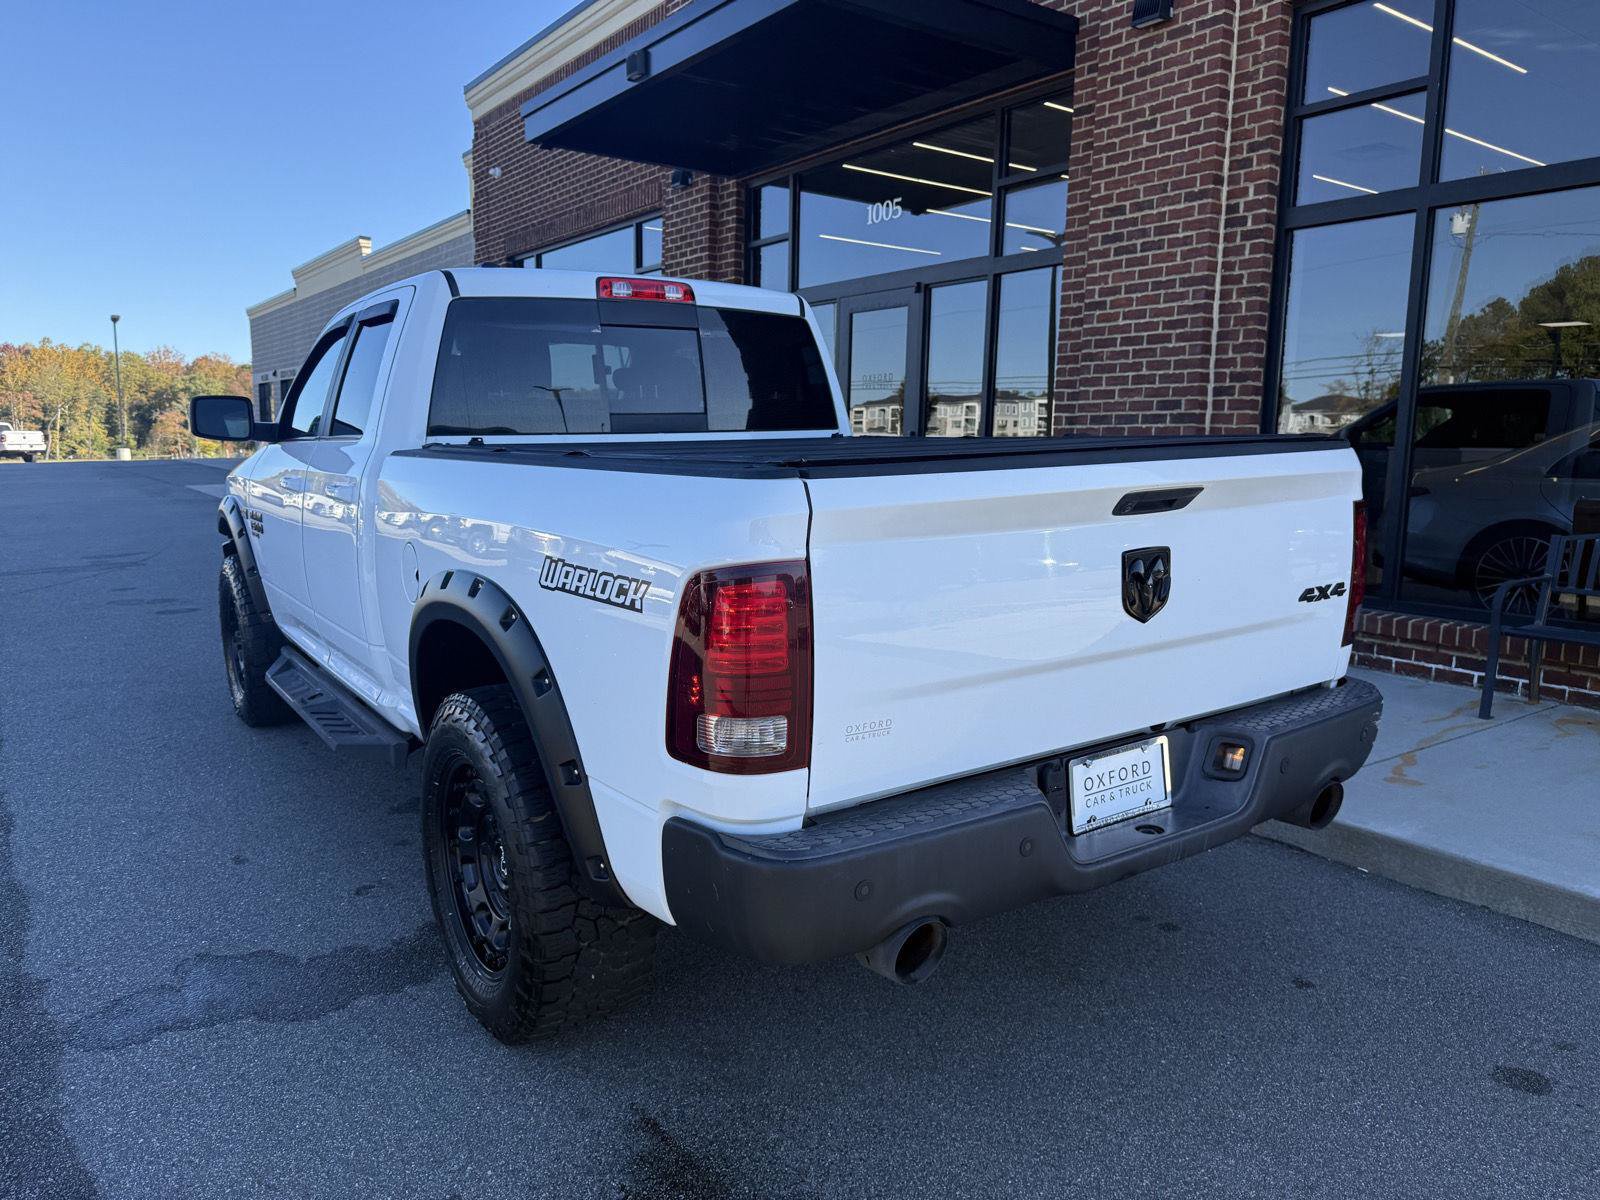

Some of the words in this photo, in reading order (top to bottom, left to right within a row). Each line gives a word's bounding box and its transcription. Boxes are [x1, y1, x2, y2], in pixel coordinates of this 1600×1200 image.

[866, 197, 903, 225] 1005
[539, 555, 652, 613] WARLOCK
[846, 719, 892, 734] OXFORD
[1084, 760, 1151, 791] OXFORD
[1085, 794, 1106, 809] CAR
[1109, 791, 1115, 801] &
[1119, 780, 1152, 799] TRUCK
